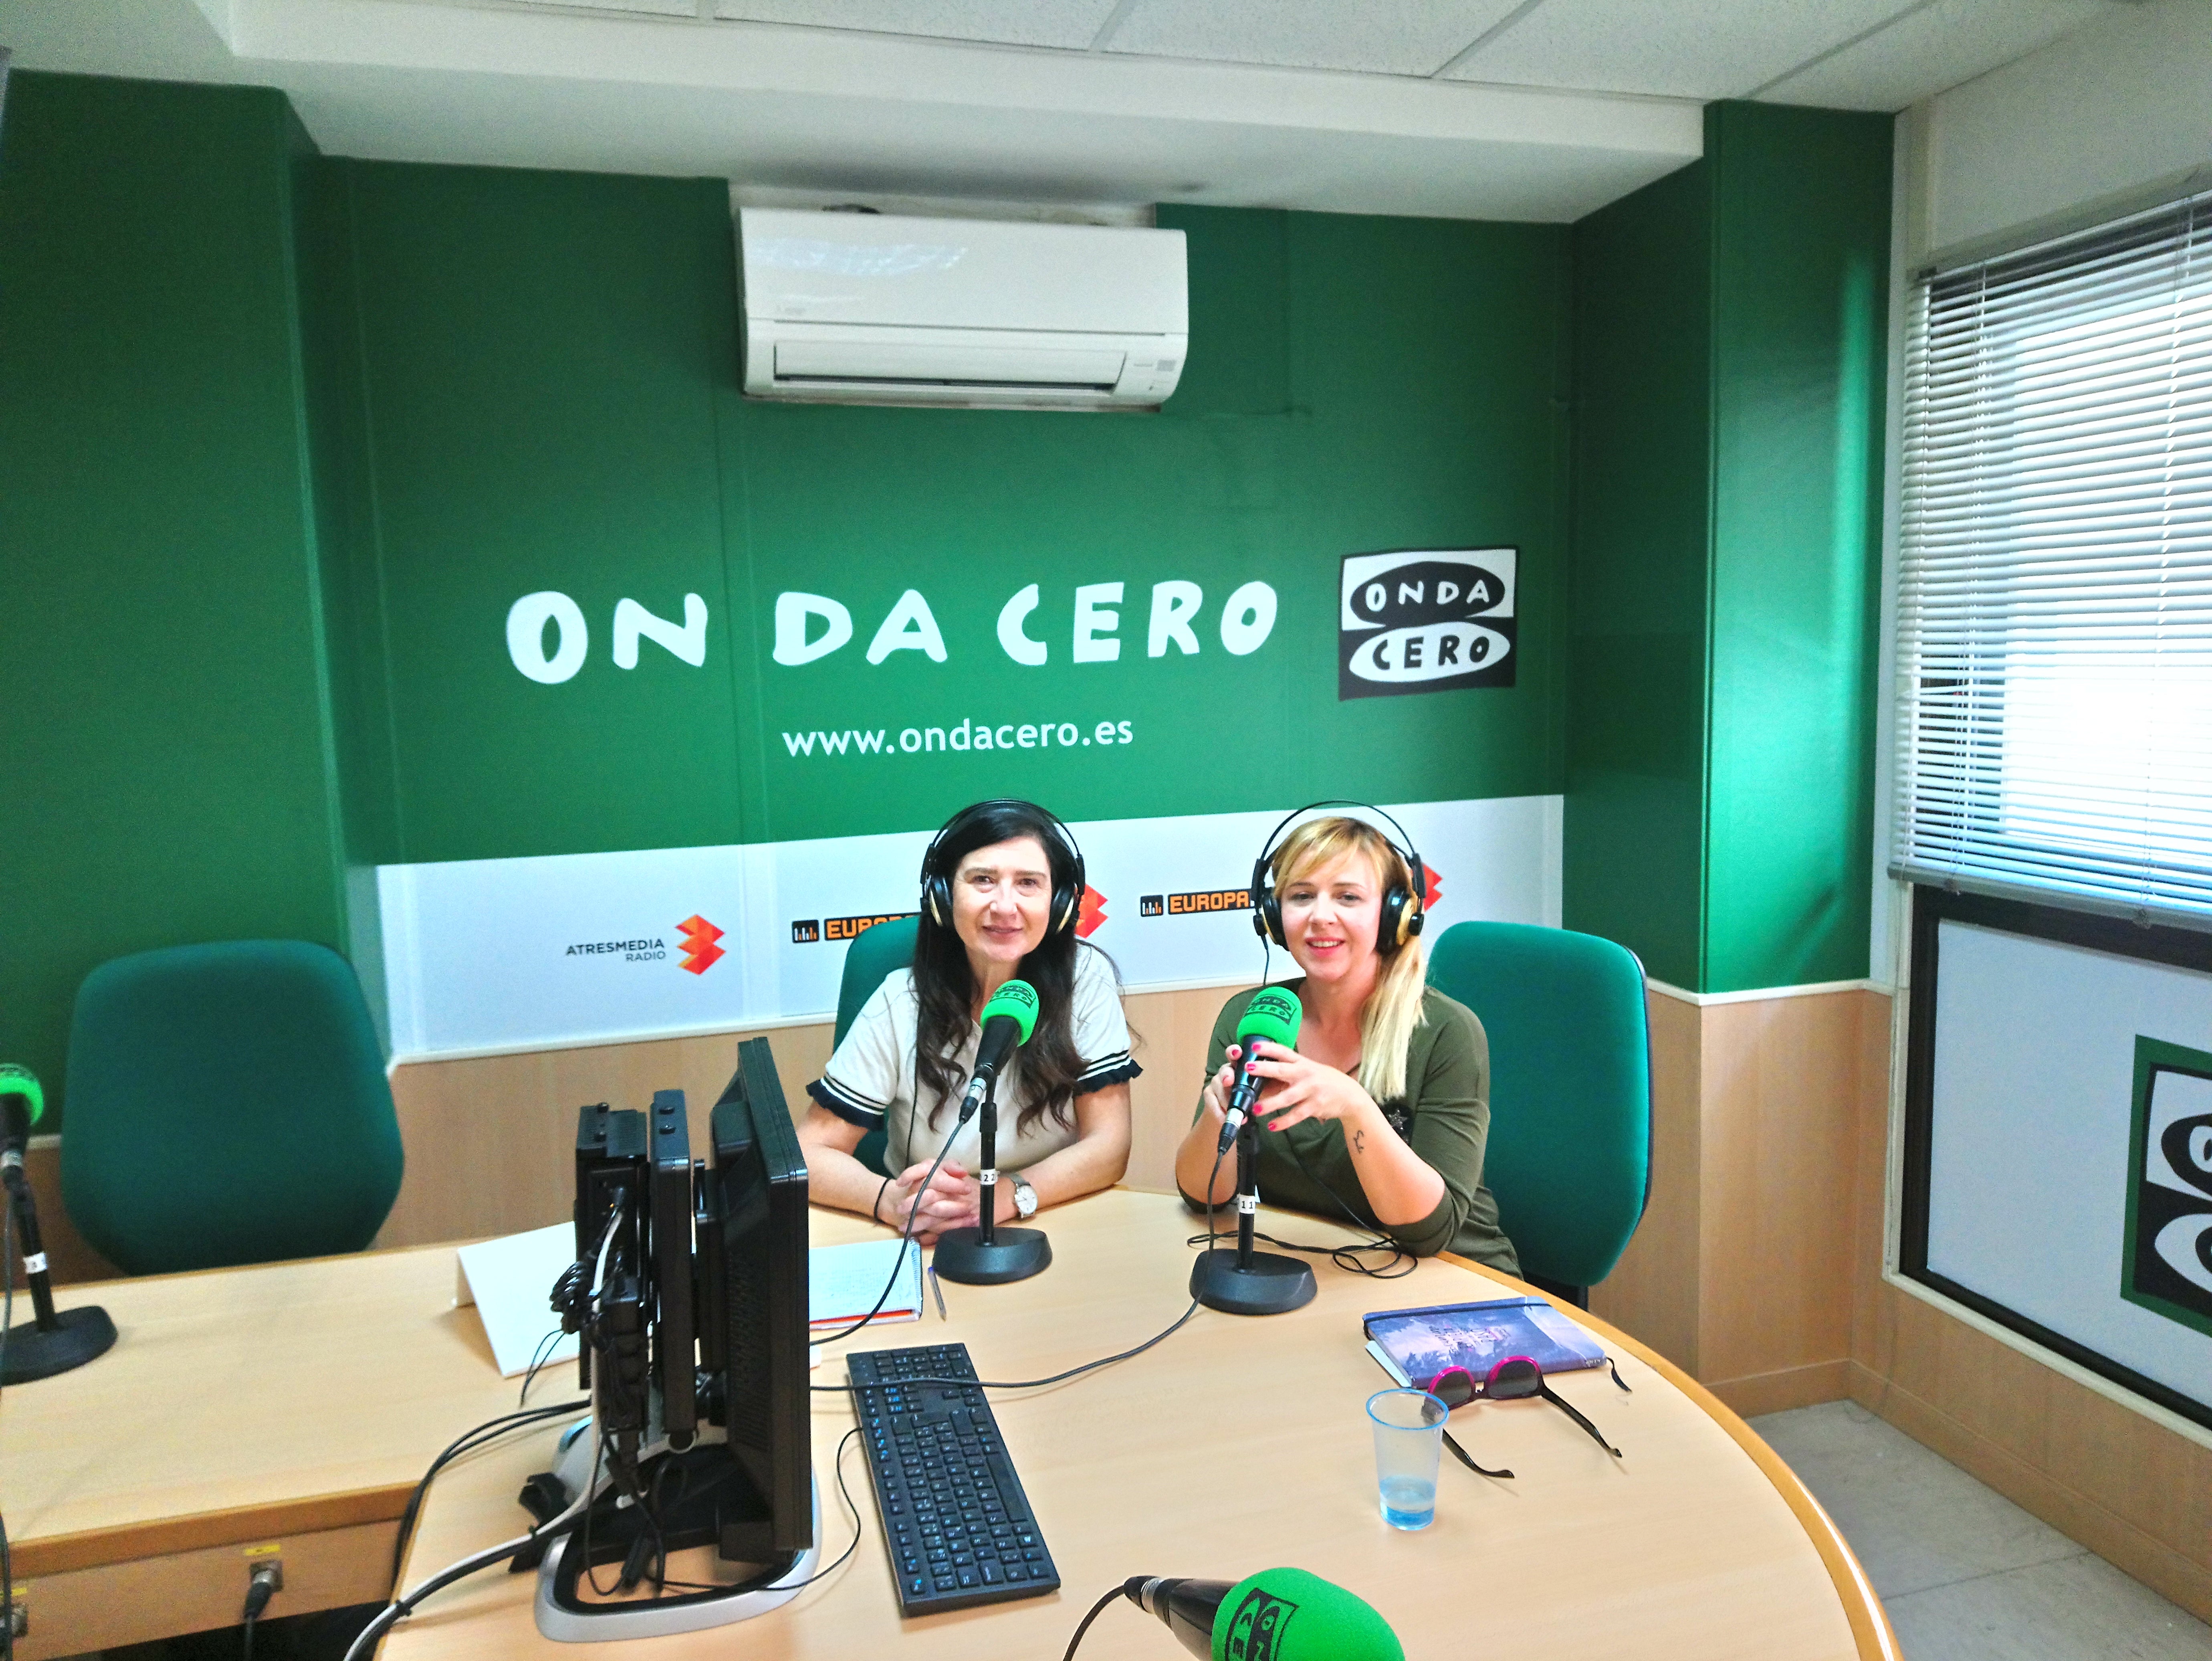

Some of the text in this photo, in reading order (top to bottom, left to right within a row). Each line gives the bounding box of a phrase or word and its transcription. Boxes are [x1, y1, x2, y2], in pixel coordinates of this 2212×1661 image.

[1366, 580, 1489, 612] ONDA
[997, 580, 1278, 666] CERO
[1372, 634, 1489, 671] CERO
[782, 718, 1133, 756] www.ondacero.es
[1170, 891, 1249, 913] EUROPA
[827, 915, 914, 939] EUR
[566, 939, 664, 956] ATRESMEDIA
[626, 951, 666, 962] RADIO
